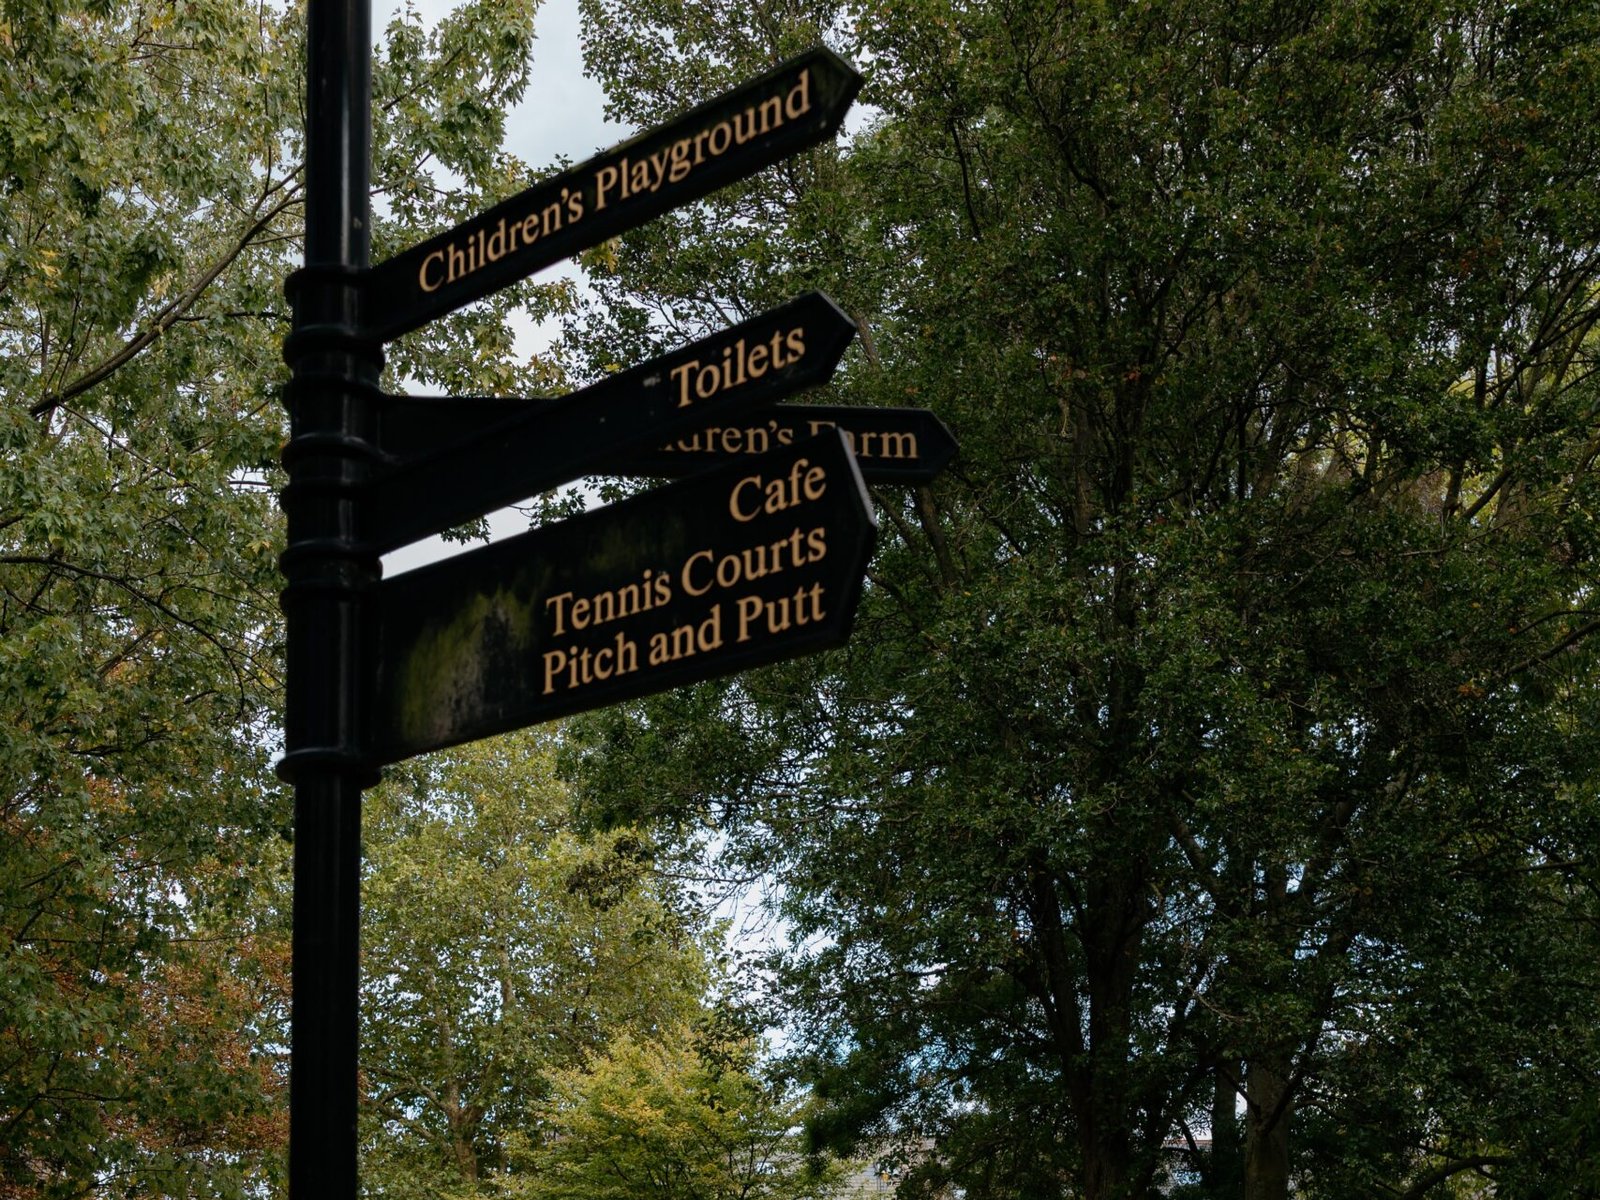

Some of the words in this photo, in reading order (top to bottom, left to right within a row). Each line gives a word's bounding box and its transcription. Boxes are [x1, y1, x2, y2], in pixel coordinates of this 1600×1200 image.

[419, 187, 584, 292] Children's
[595, 69, 810, 212] Playground
[670, 327, 805, 408] Toilets
[658, 420, 794, 453] ren's
[729, 458, 826, 522] Cafe
[546, 569, 671, 637] Tennis
[681, 527, 827, 596] Courts
[542, 631, 638, 694] Pitch
[649, 603, 723, 666] and
[736, 582, 826, 642] Putt
